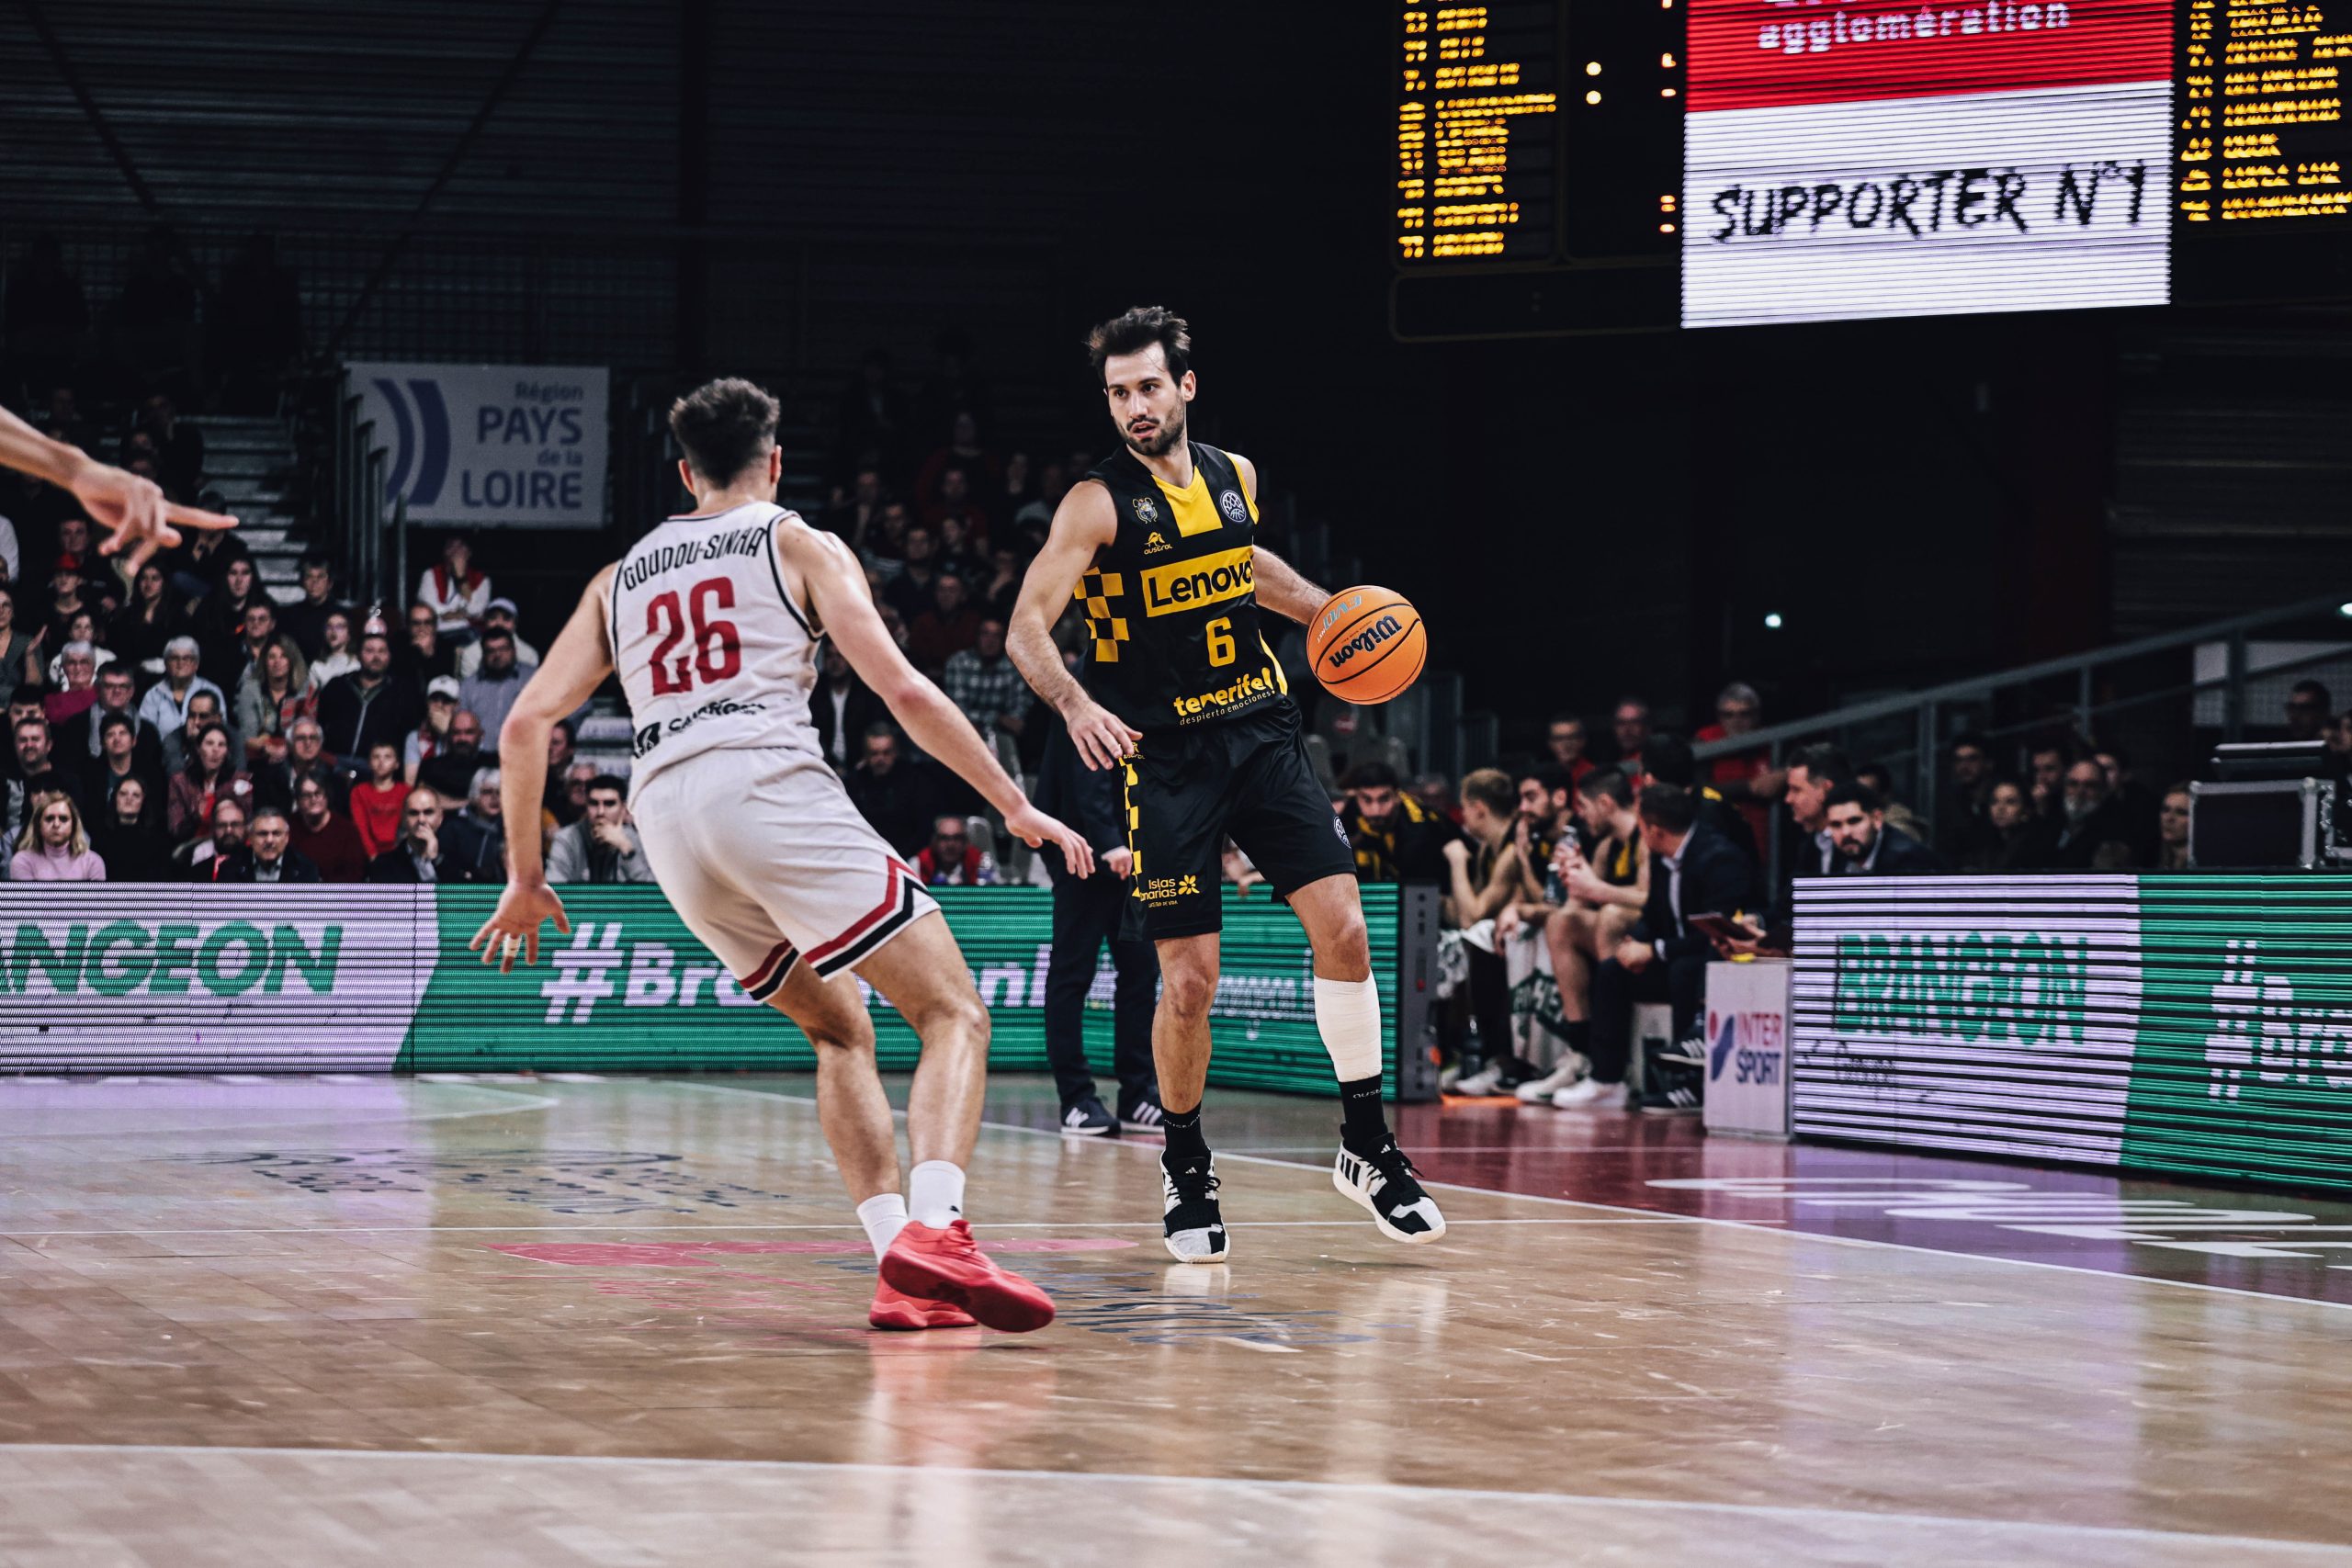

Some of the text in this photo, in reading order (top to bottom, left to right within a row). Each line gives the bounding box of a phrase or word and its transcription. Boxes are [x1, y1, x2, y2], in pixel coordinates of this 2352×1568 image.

[1711, 169, 2029, 243] SUPPORTER
[515, 382, 583, 404] Région
[478, 406, 582, 445] PAYS
[537, 449, 582, 466] de la
[462, 469, 582, 508] LOIRE
[1148, 559, 1252, 608] Lenovo
[647, 576, 741, 696] 26
[1205, 616, 1236, 667] 6
[1329, 615, 1402, 668] Wilson
[1180, 708, 1225, 726] despierta
[1148, 878, 1176, 889] Islas
[1736, 1012, 1782, 1046] INTER
[1736, 1049, 1781, 1085] SPORT
